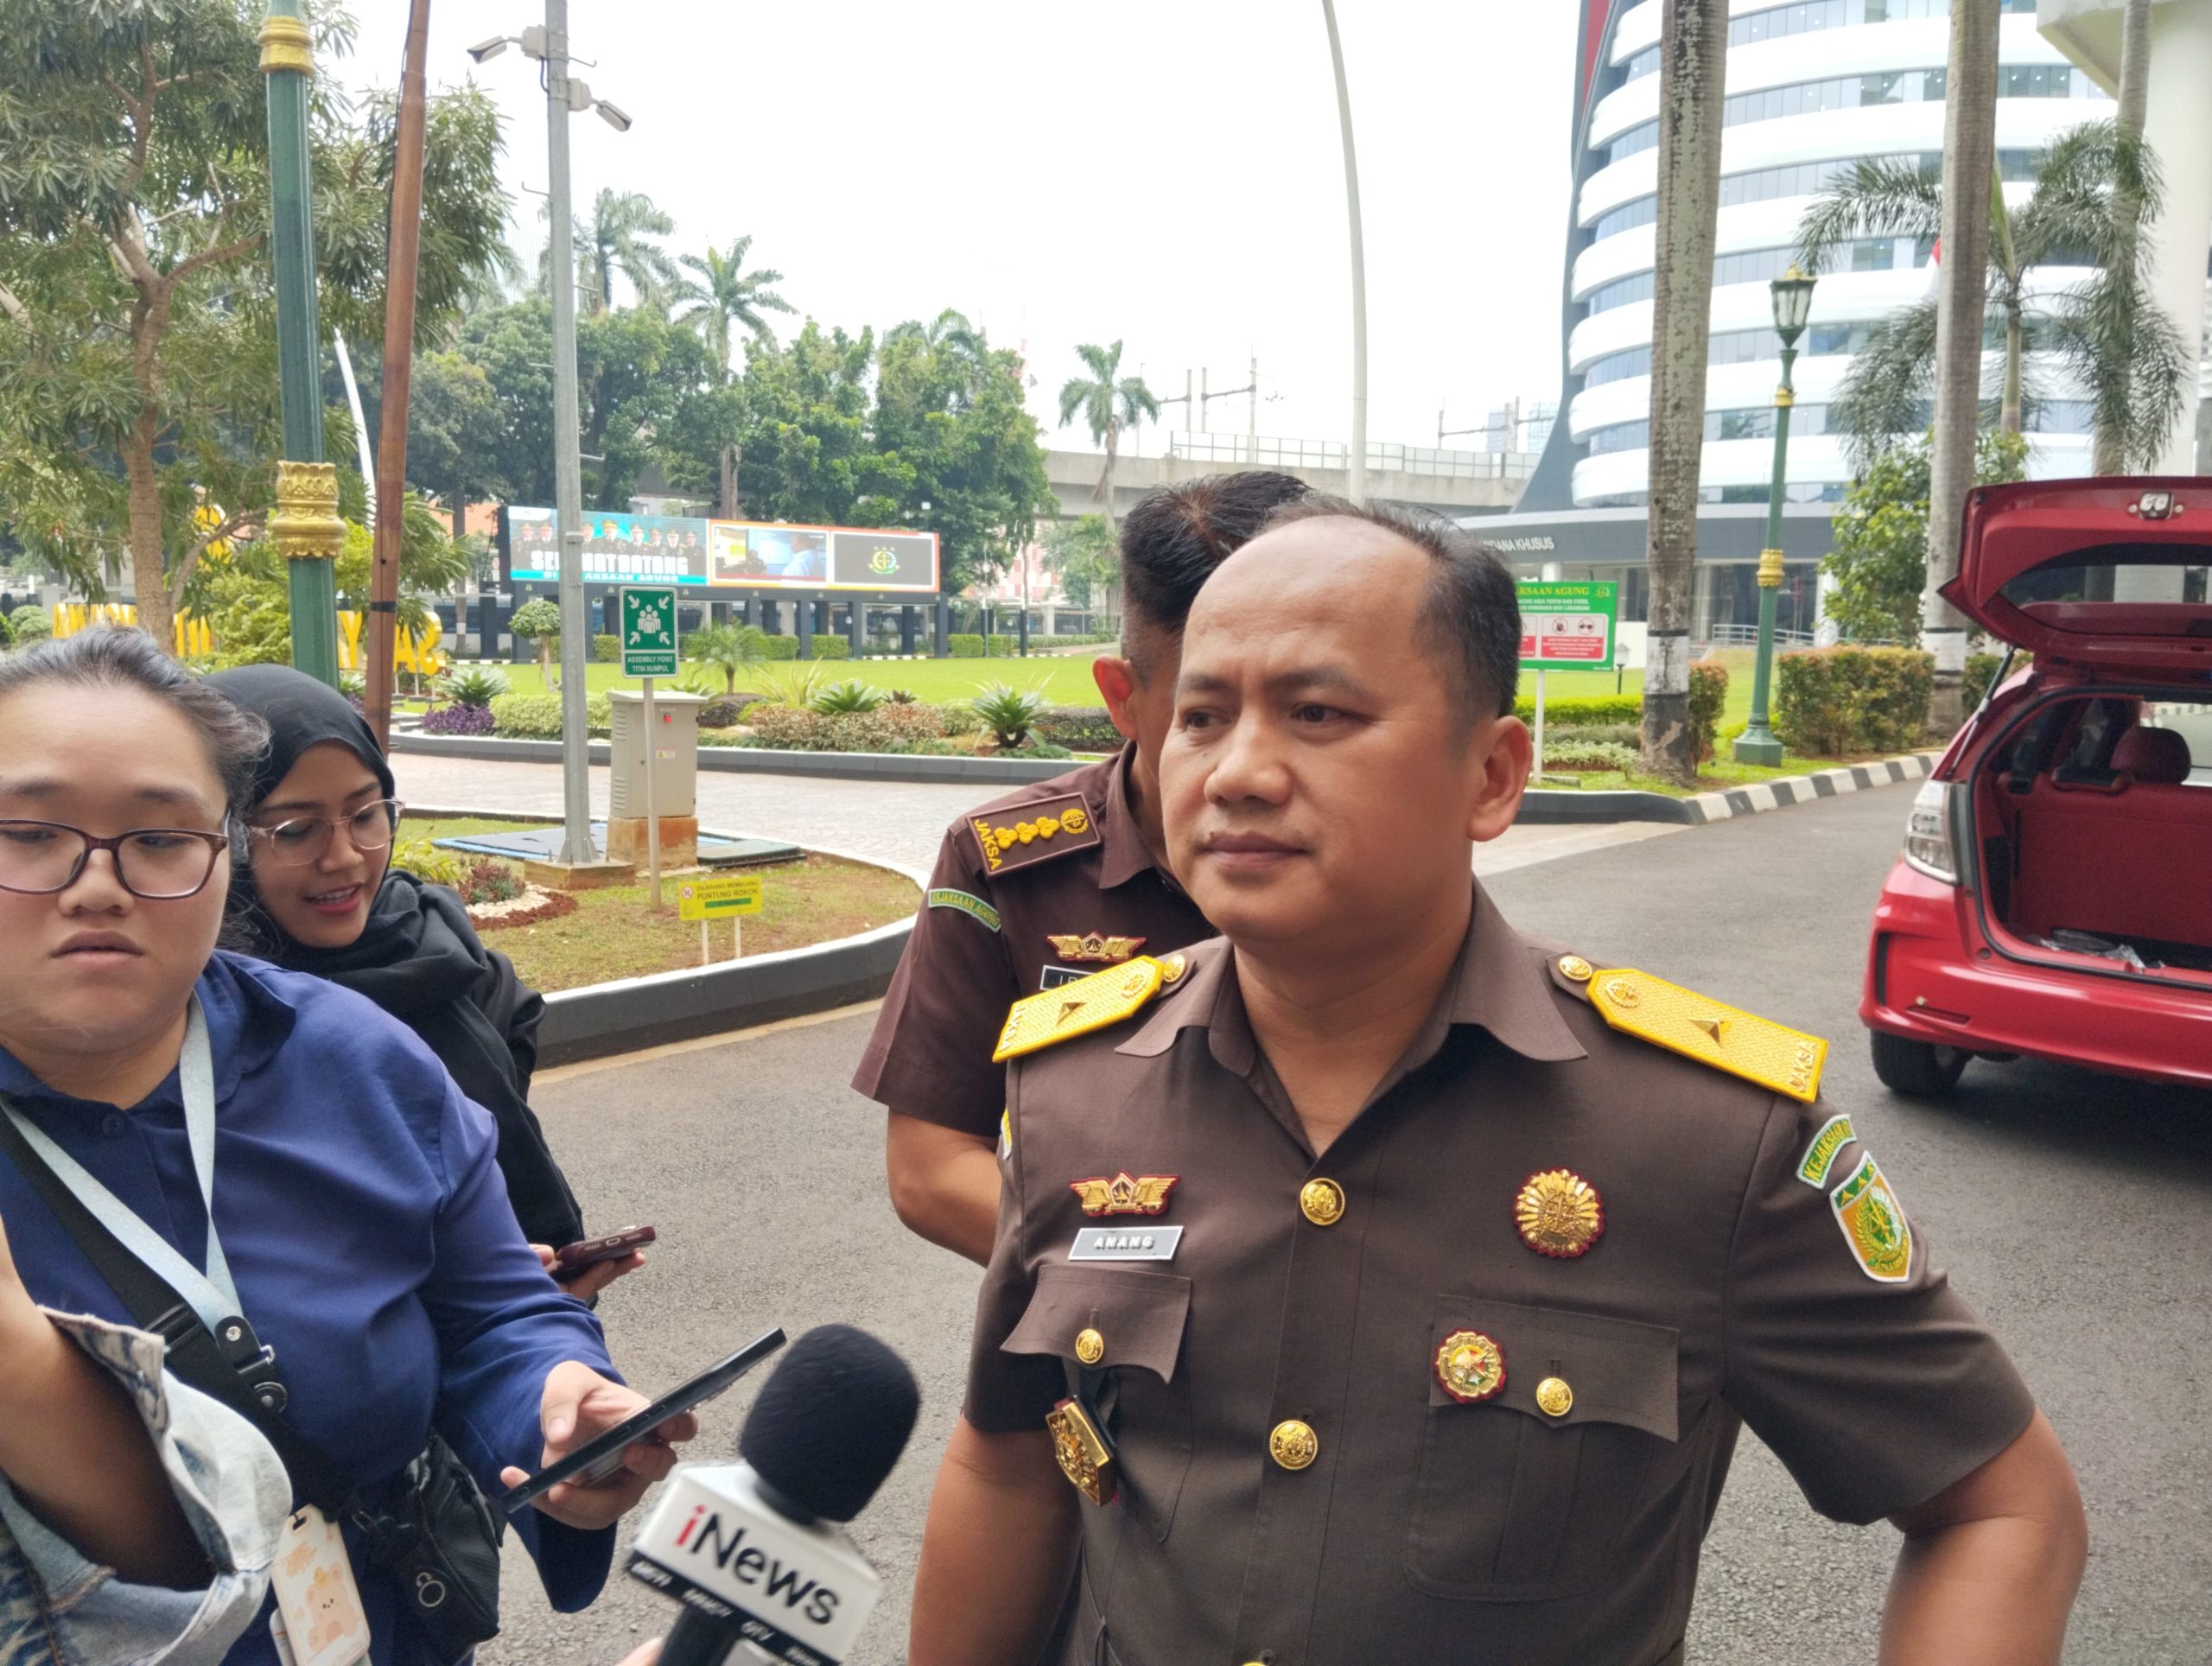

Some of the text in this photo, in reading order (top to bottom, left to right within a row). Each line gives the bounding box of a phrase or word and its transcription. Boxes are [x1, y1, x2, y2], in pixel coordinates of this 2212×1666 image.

[1516, 537, 1554, 550] KHUSUS
[531, 550, 689, 575] SEMAT DATANG
[1554, 587, 1589, 595] AGUNG
[974, 818, 1002, 871] JAKSA
[697, 888, 759, 900] PUNTUNG ROKOK
[932, 892, 999, 926] KEJAKSAAN AGUNG
[1789, 1040, 1818, 1093] JAKSA
[1093, 1236, 1154, 1250] ANANG
[674, 1504, 841, 1625] iNews
